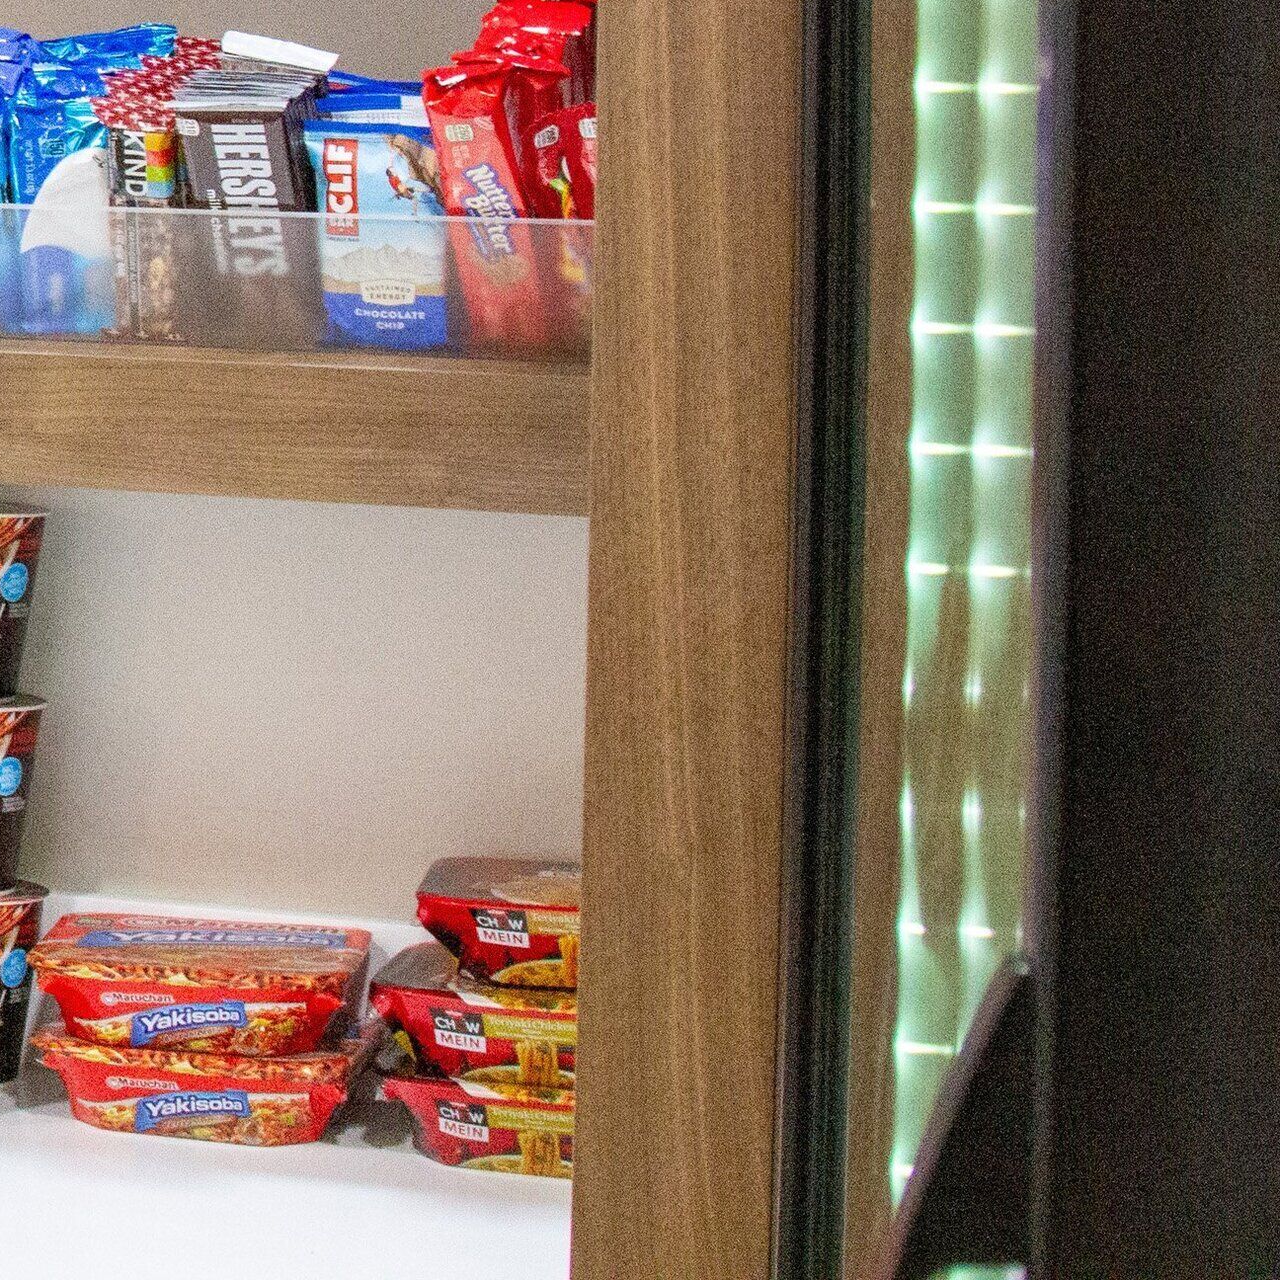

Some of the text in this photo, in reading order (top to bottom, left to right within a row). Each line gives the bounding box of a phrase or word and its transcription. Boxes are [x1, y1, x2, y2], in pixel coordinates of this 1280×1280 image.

[123, 130, 147, 197] KIND
[327, 144, 355, 214] CLIF
[354, 308, 426, 320] CHOCOLATE
[112, 992, 176, 1004] Maruchan
[141, 1008, 242, 1033] Yakisoba
[116, 1078, 179, 1090] Maruchan
[145, 1097, 244, 1119] Yakisoba
